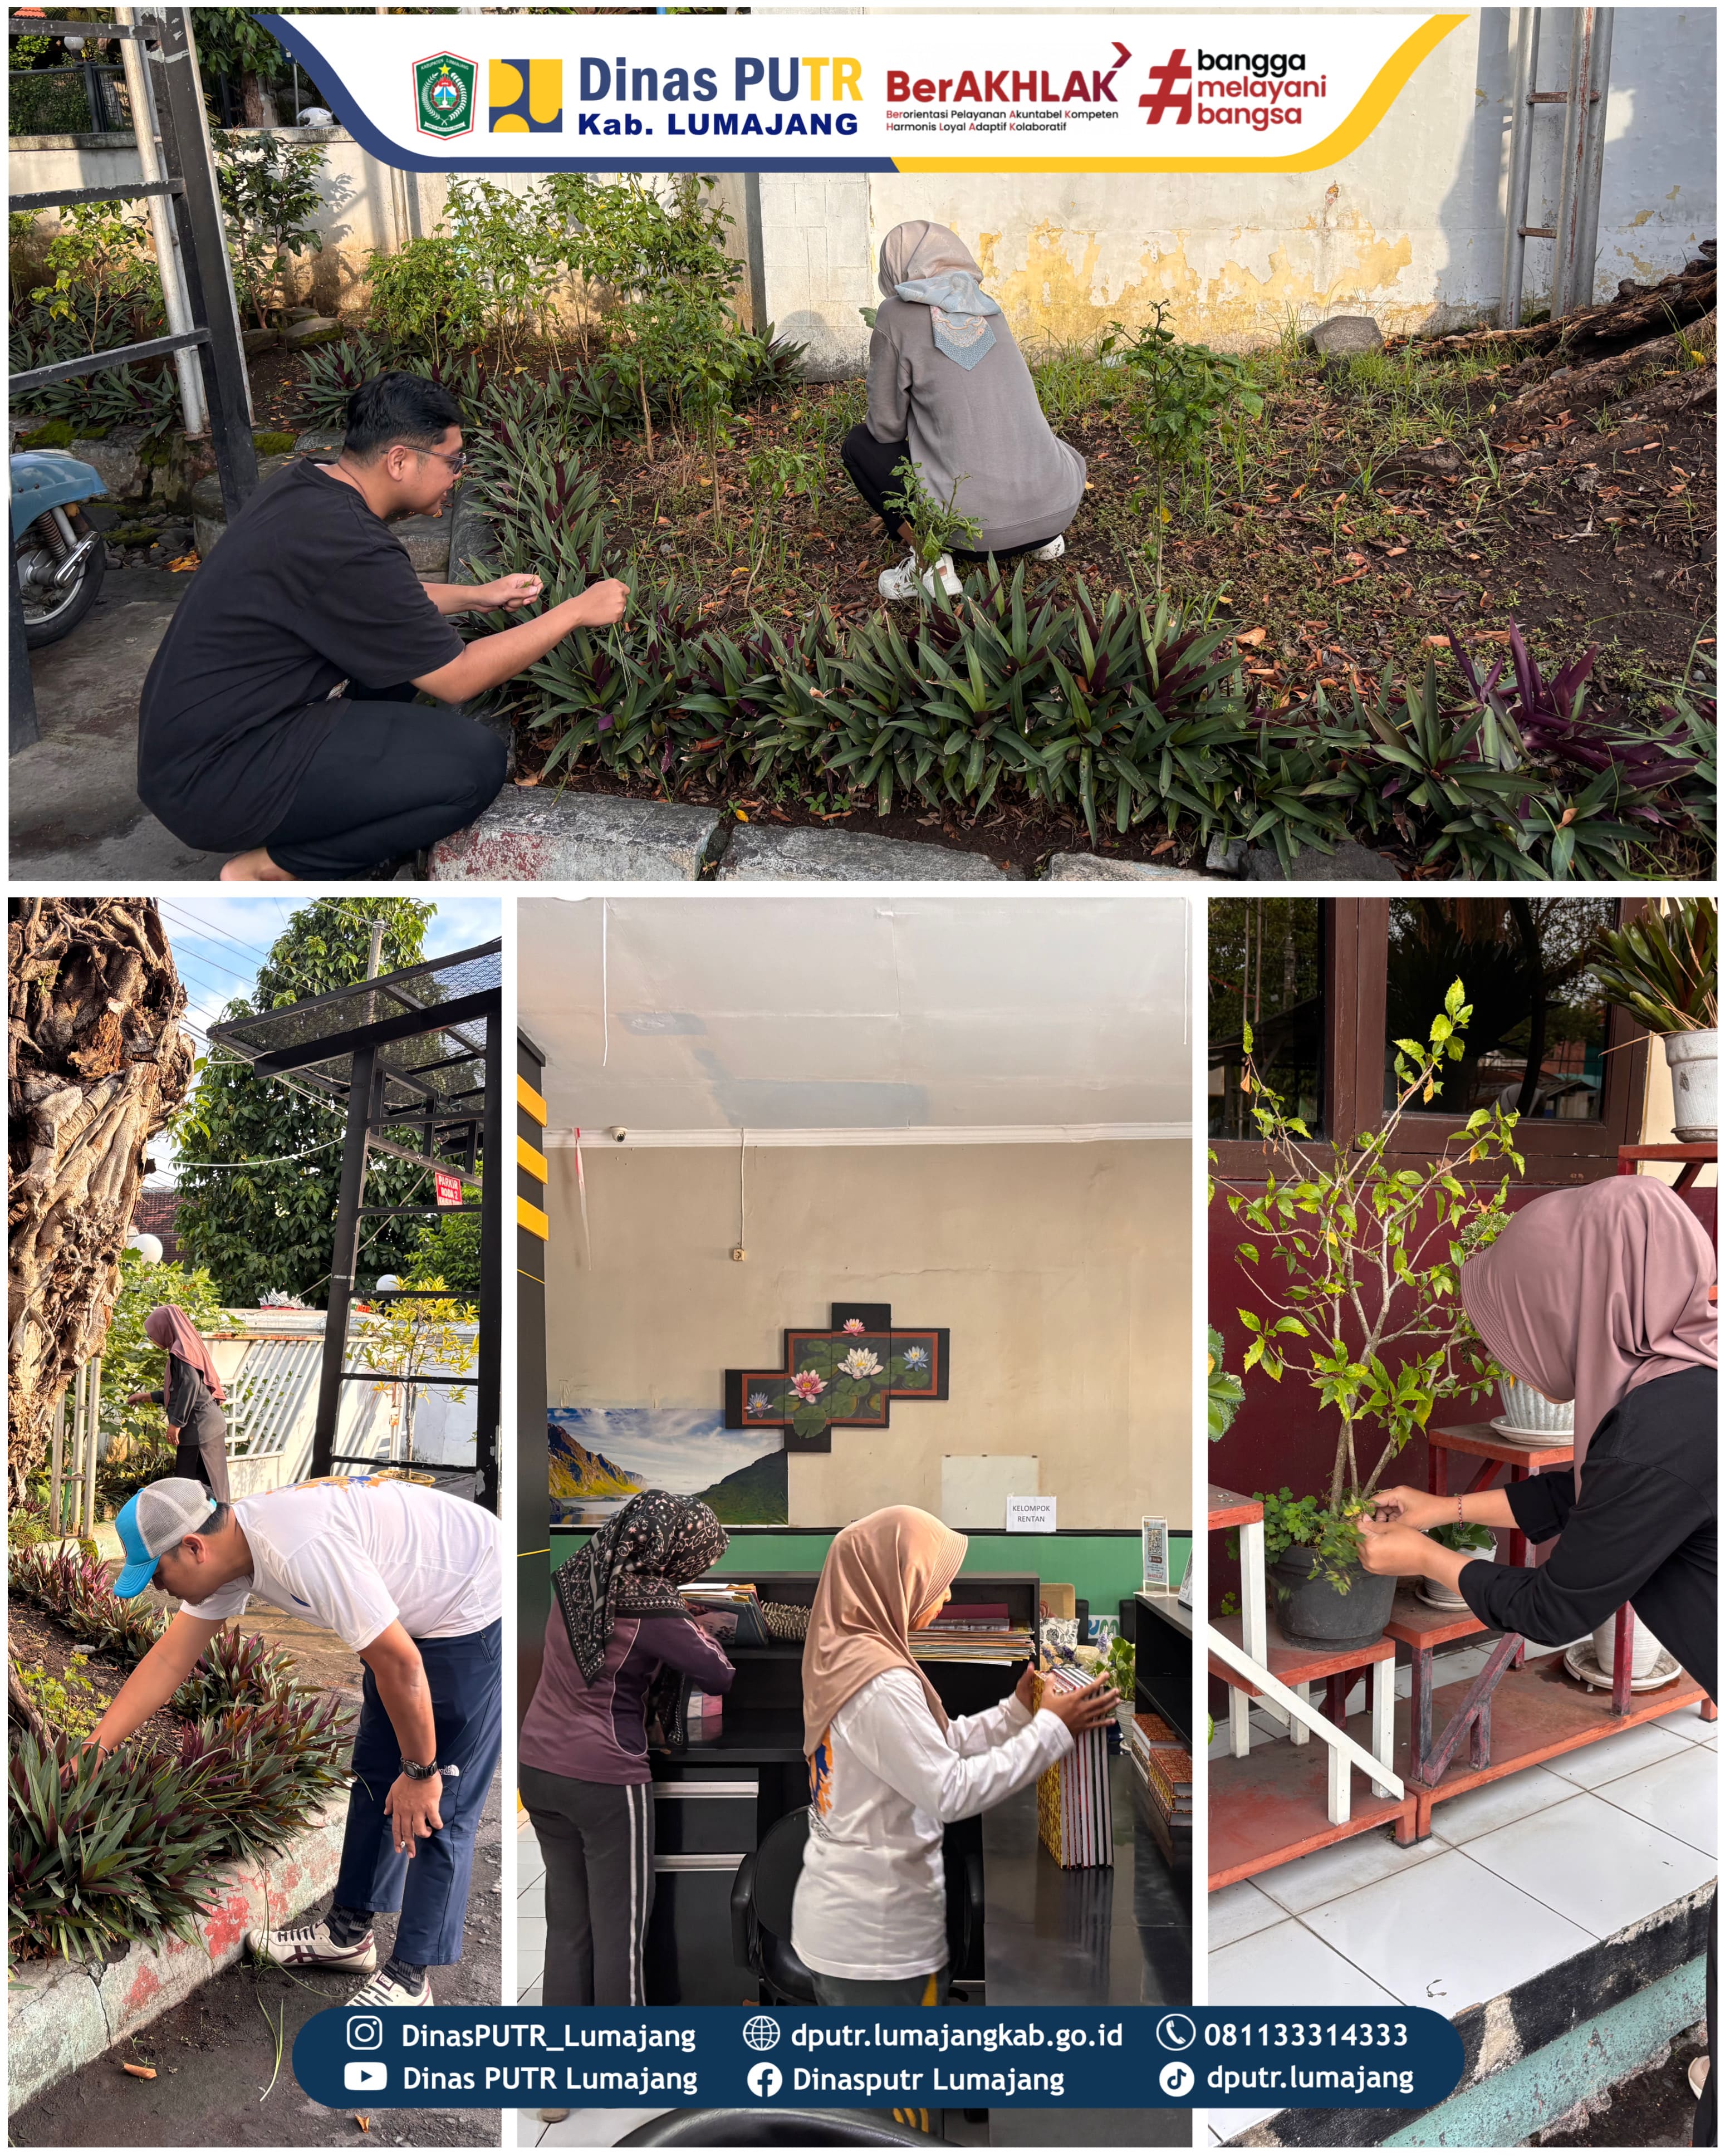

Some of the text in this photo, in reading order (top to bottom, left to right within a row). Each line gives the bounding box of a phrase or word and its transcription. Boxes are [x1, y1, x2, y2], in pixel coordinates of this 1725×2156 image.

[438, 1175, 458, 1189] PARKIR
[440, 1187, 458, 1200] RODA 2
